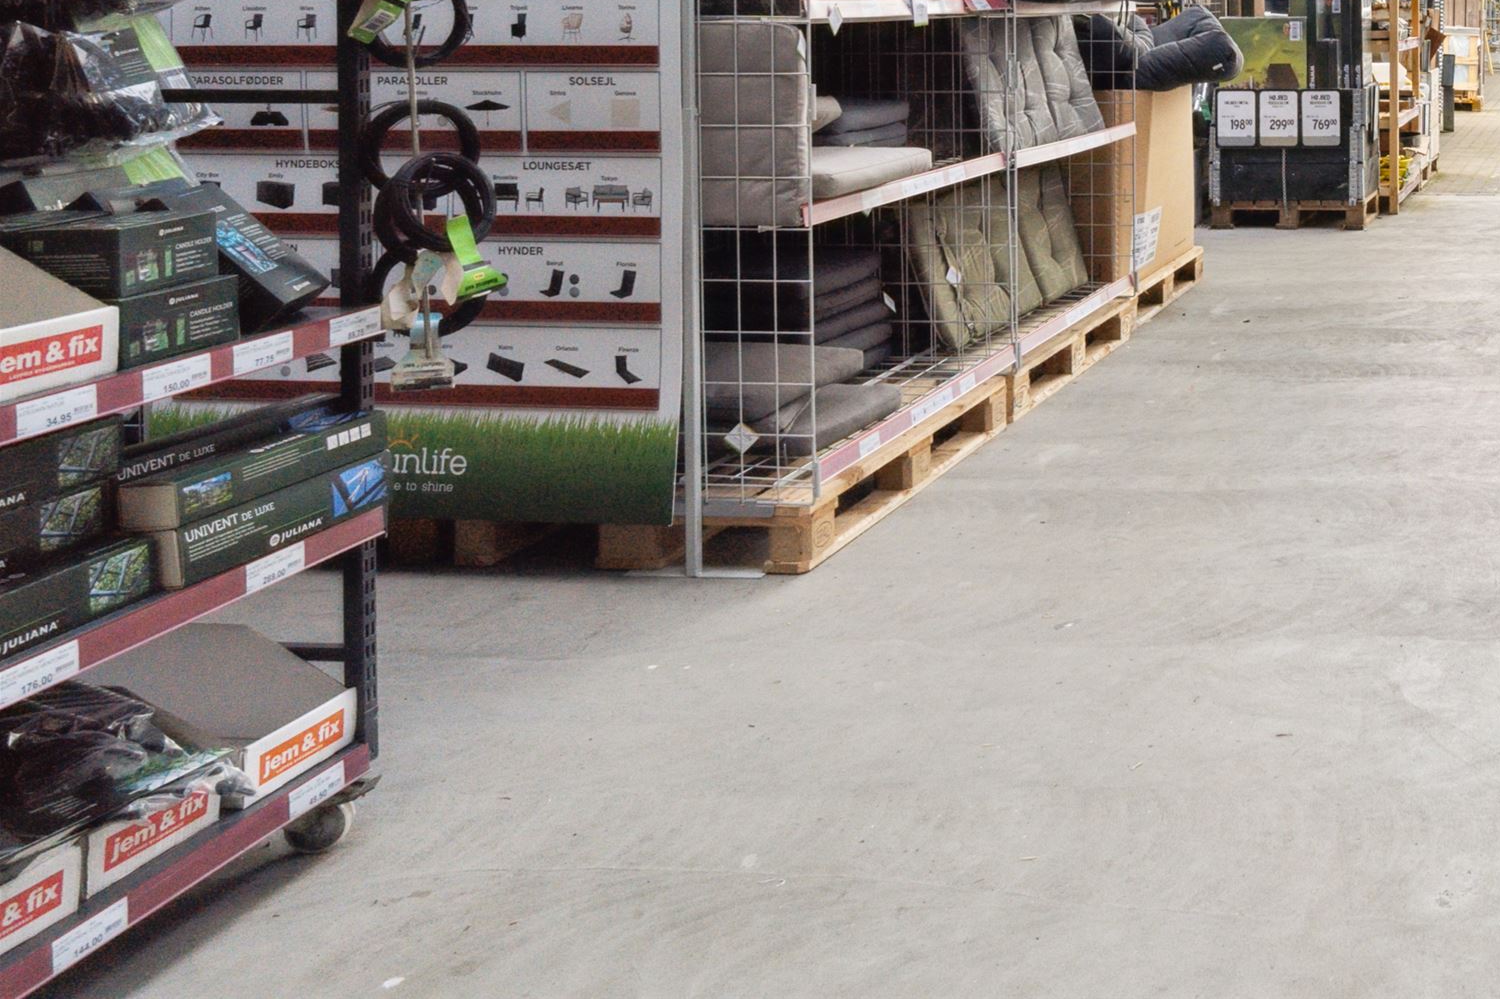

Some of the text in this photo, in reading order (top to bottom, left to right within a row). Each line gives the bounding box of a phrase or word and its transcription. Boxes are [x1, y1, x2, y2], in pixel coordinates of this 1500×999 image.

[569, 75, 616, 86] SOLSEJL
[523, 161, 591, 171] LOUNGESÆT
[498, 246, 543, 256] HYNDER
[46, 341, 65, 363] &
[68, 334, 99, 358] fix
[163, 379, 190, 394] 150.00
[45, 412, 72, 427] 34.95
[406, 481, 417, 491] to
[421, 481, 454, 492] shine
[185, 502, 275, 542] UNIVENT DE LUXE
[280, 517, 325, 542] JULIANA
[21, 673, 53, 695] 176.00
[263, 719, 340, 779] jem & fix
[160, 809, 177, 832] &
[179, 792, 207, 820] fix
[2, 882, 60, 927] & fix
